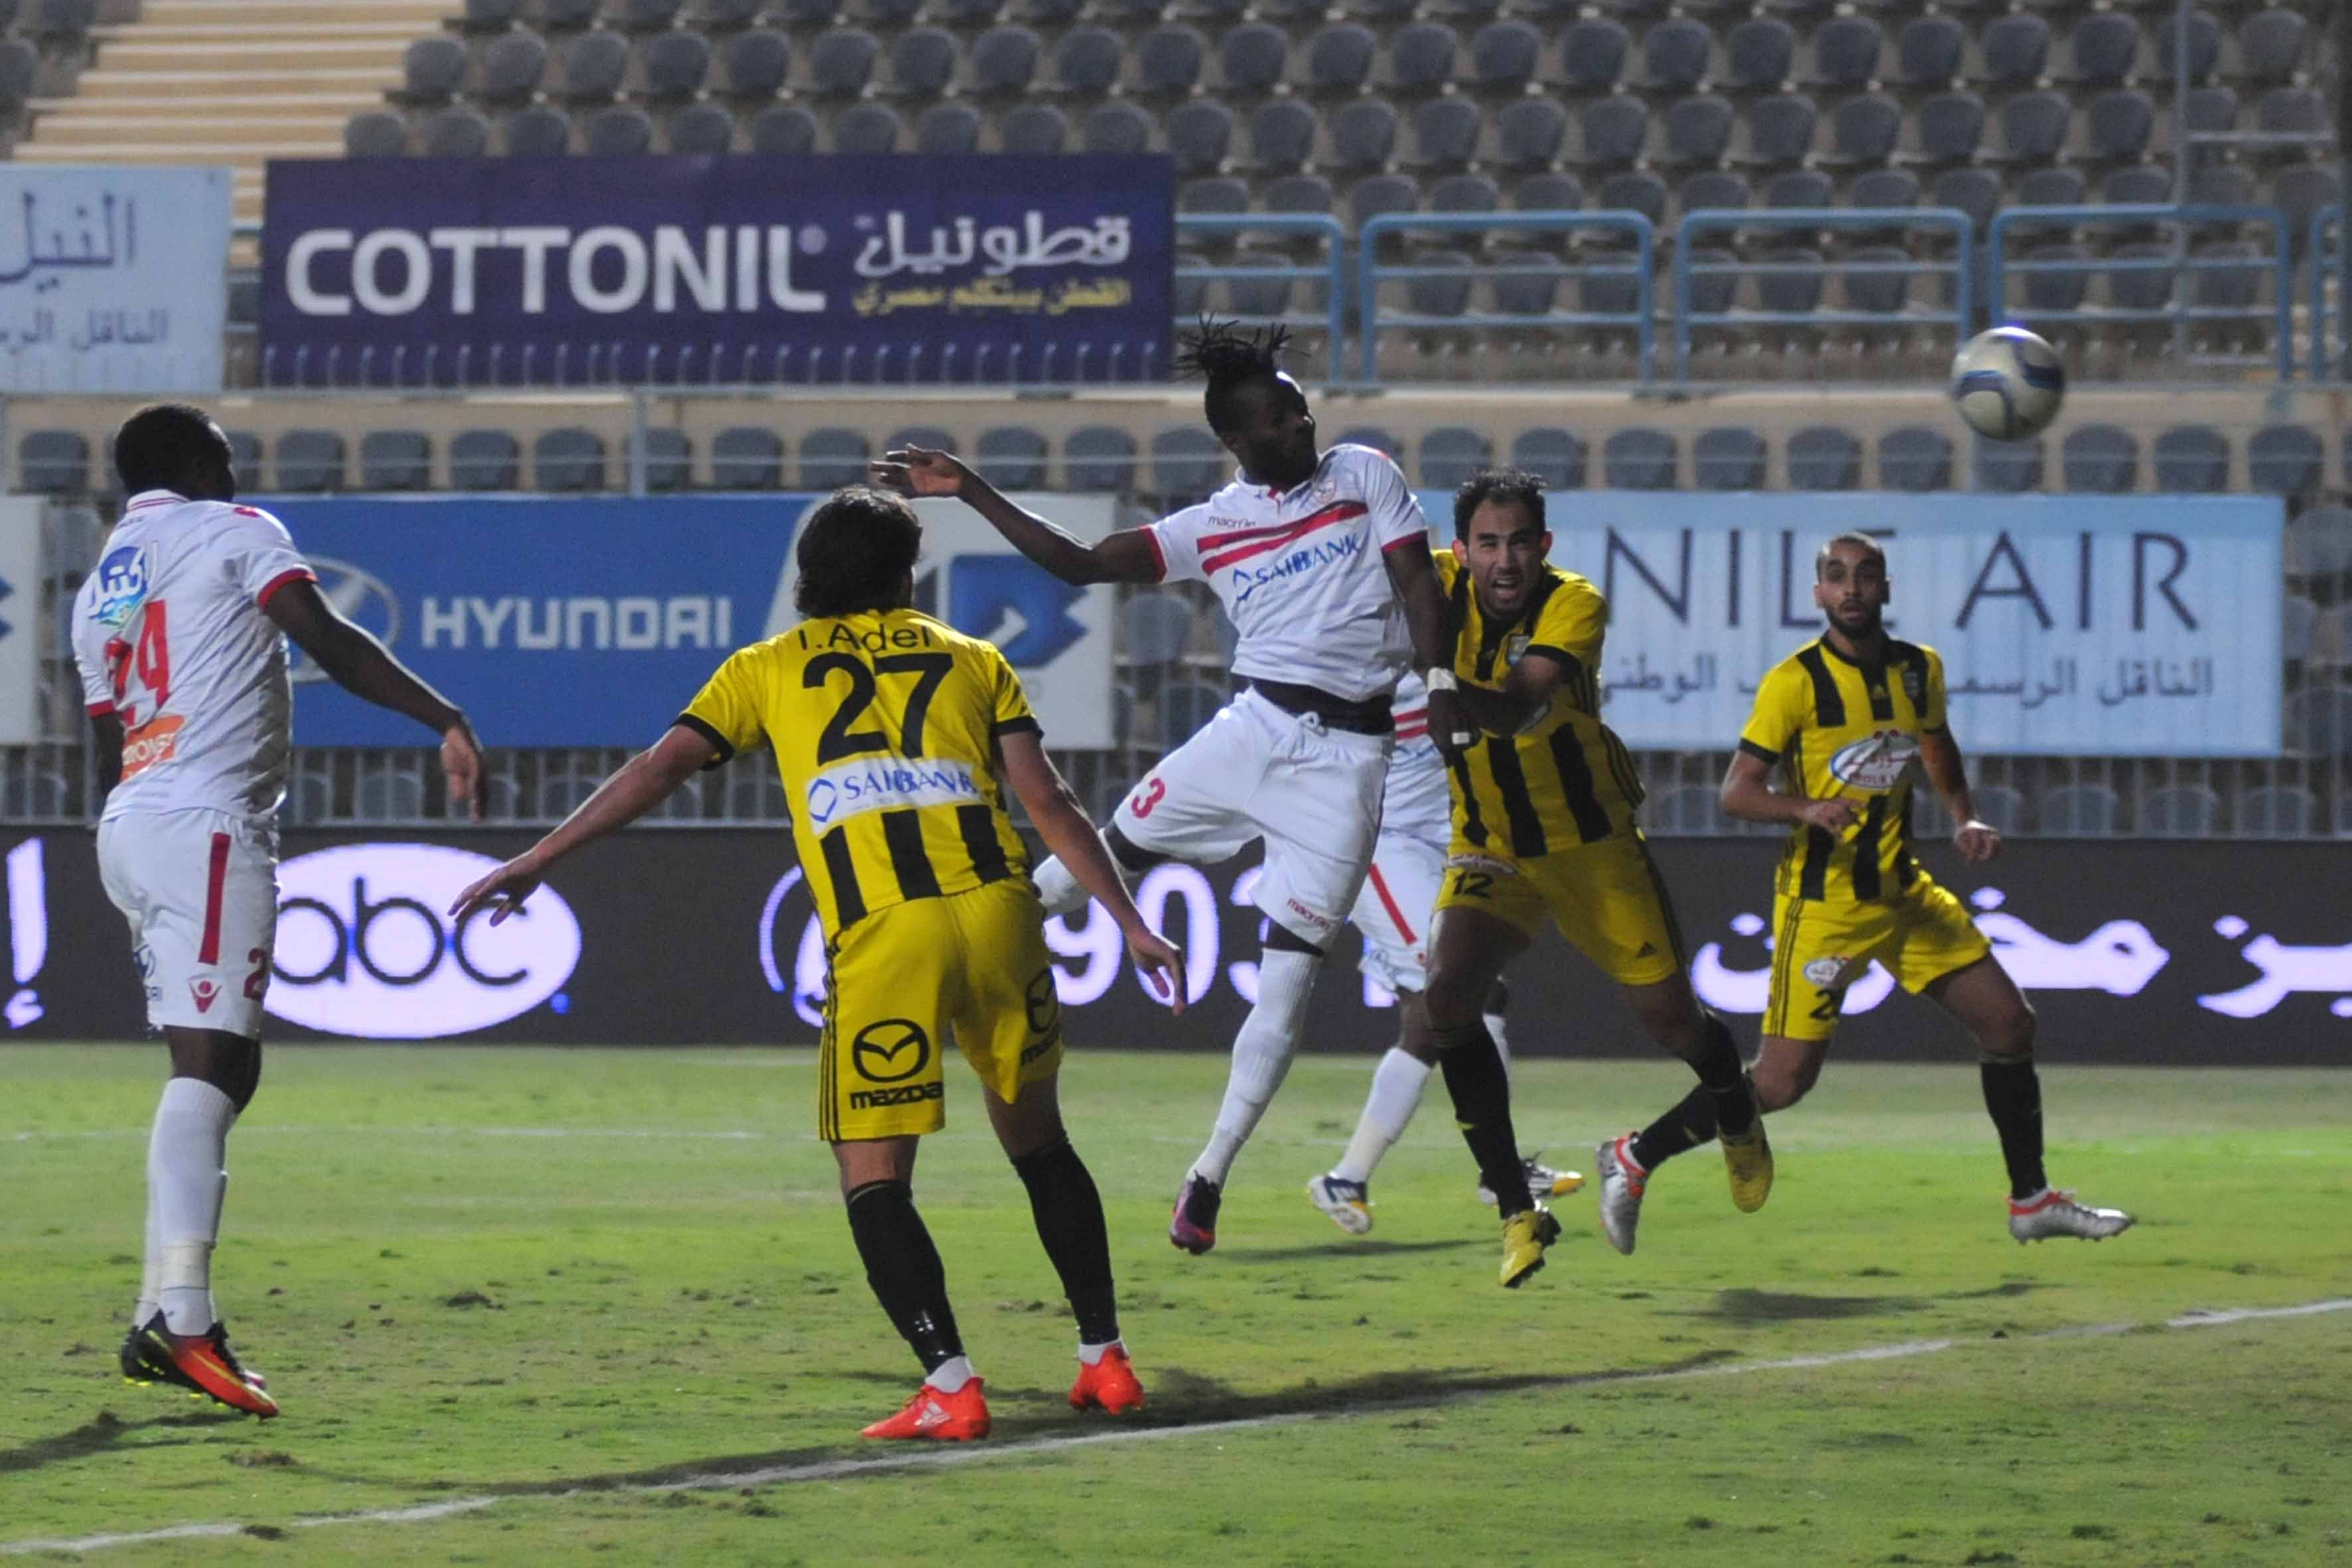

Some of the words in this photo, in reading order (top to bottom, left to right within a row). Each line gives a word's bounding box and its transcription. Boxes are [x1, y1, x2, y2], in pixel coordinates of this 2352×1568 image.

[285, 226, 826, 315] COTTONIL
[854, 210, 1131, 277] قطونيل
[1605, 526, 1895, 629] NIL
[1955, 528, 2199, 631] AIR
[421, 595, 732, 650] HYUNDAI
[802, 652, 954, 767] 27
[1131, 777, 1165, 819] 3
[1453, 871, 1494, 898] 12
[272, 876, 530, 986] abc
[1809, 989, 1839, 1021] 2
[850, 1081, 944, 1110] mazda
